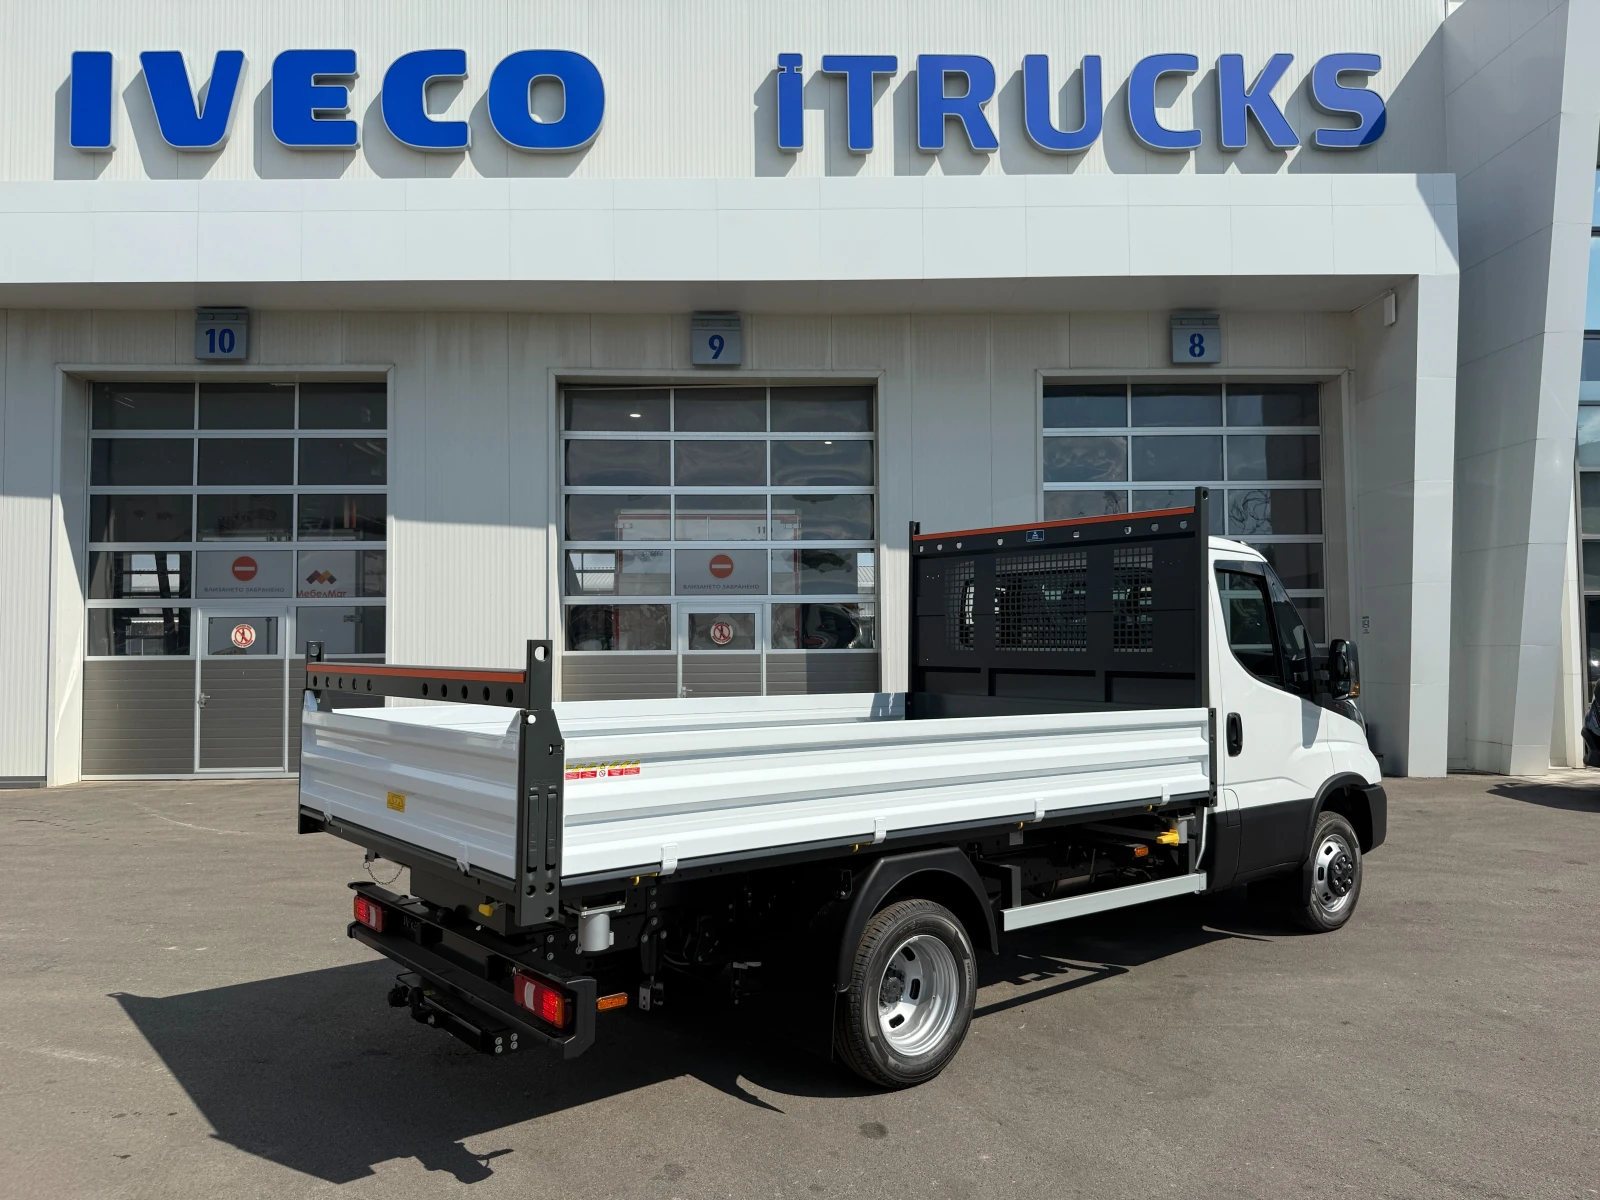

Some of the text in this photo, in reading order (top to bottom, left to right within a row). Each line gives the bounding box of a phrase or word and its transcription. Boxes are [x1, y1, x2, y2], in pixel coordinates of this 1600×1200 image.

[69, 49, 606, 153] IVECO
[205, 328, 235, 354] 10
[708, 334, 725, 360] 9
[1188, 332, 1205, 358] 8
